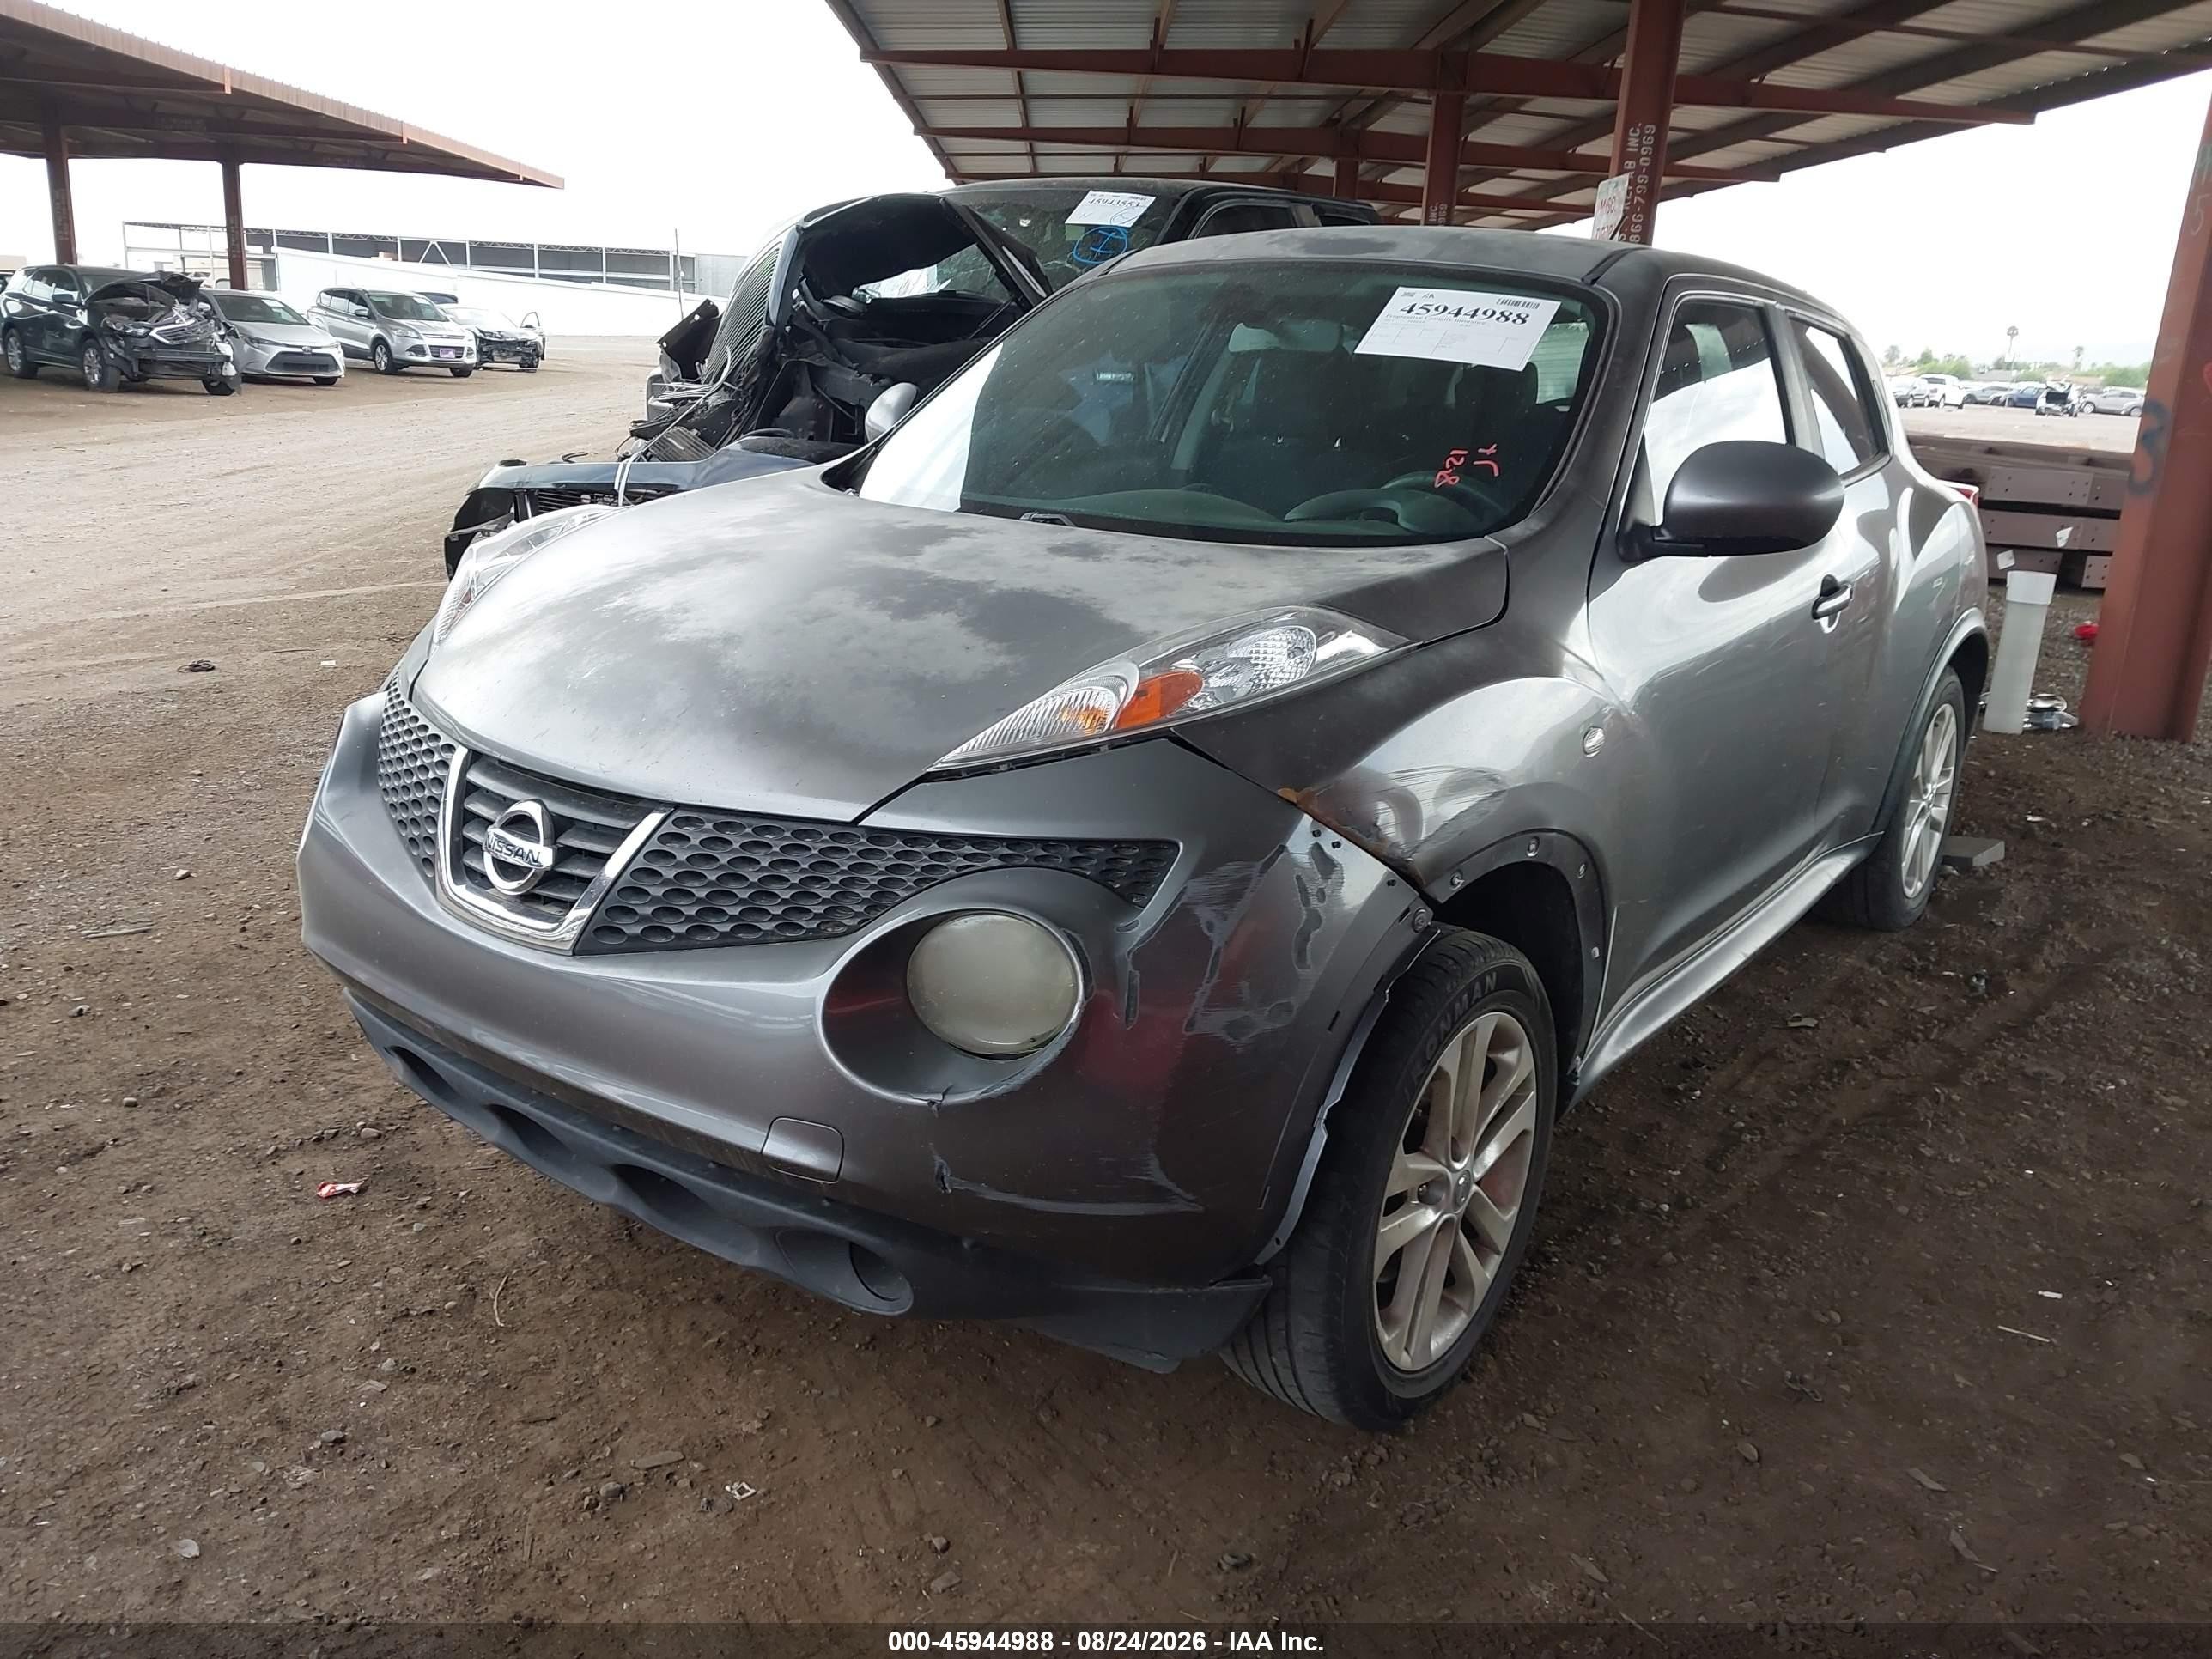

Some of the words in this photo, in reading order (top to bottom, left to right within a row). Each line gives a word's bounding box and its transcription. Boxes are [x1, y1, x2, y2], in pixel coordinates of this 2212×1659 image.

[1626, 123, 1642, 152] INC.
[1400, 302, 1530, 325] 45944988
[485, 834, 542, 866] NISSAN
